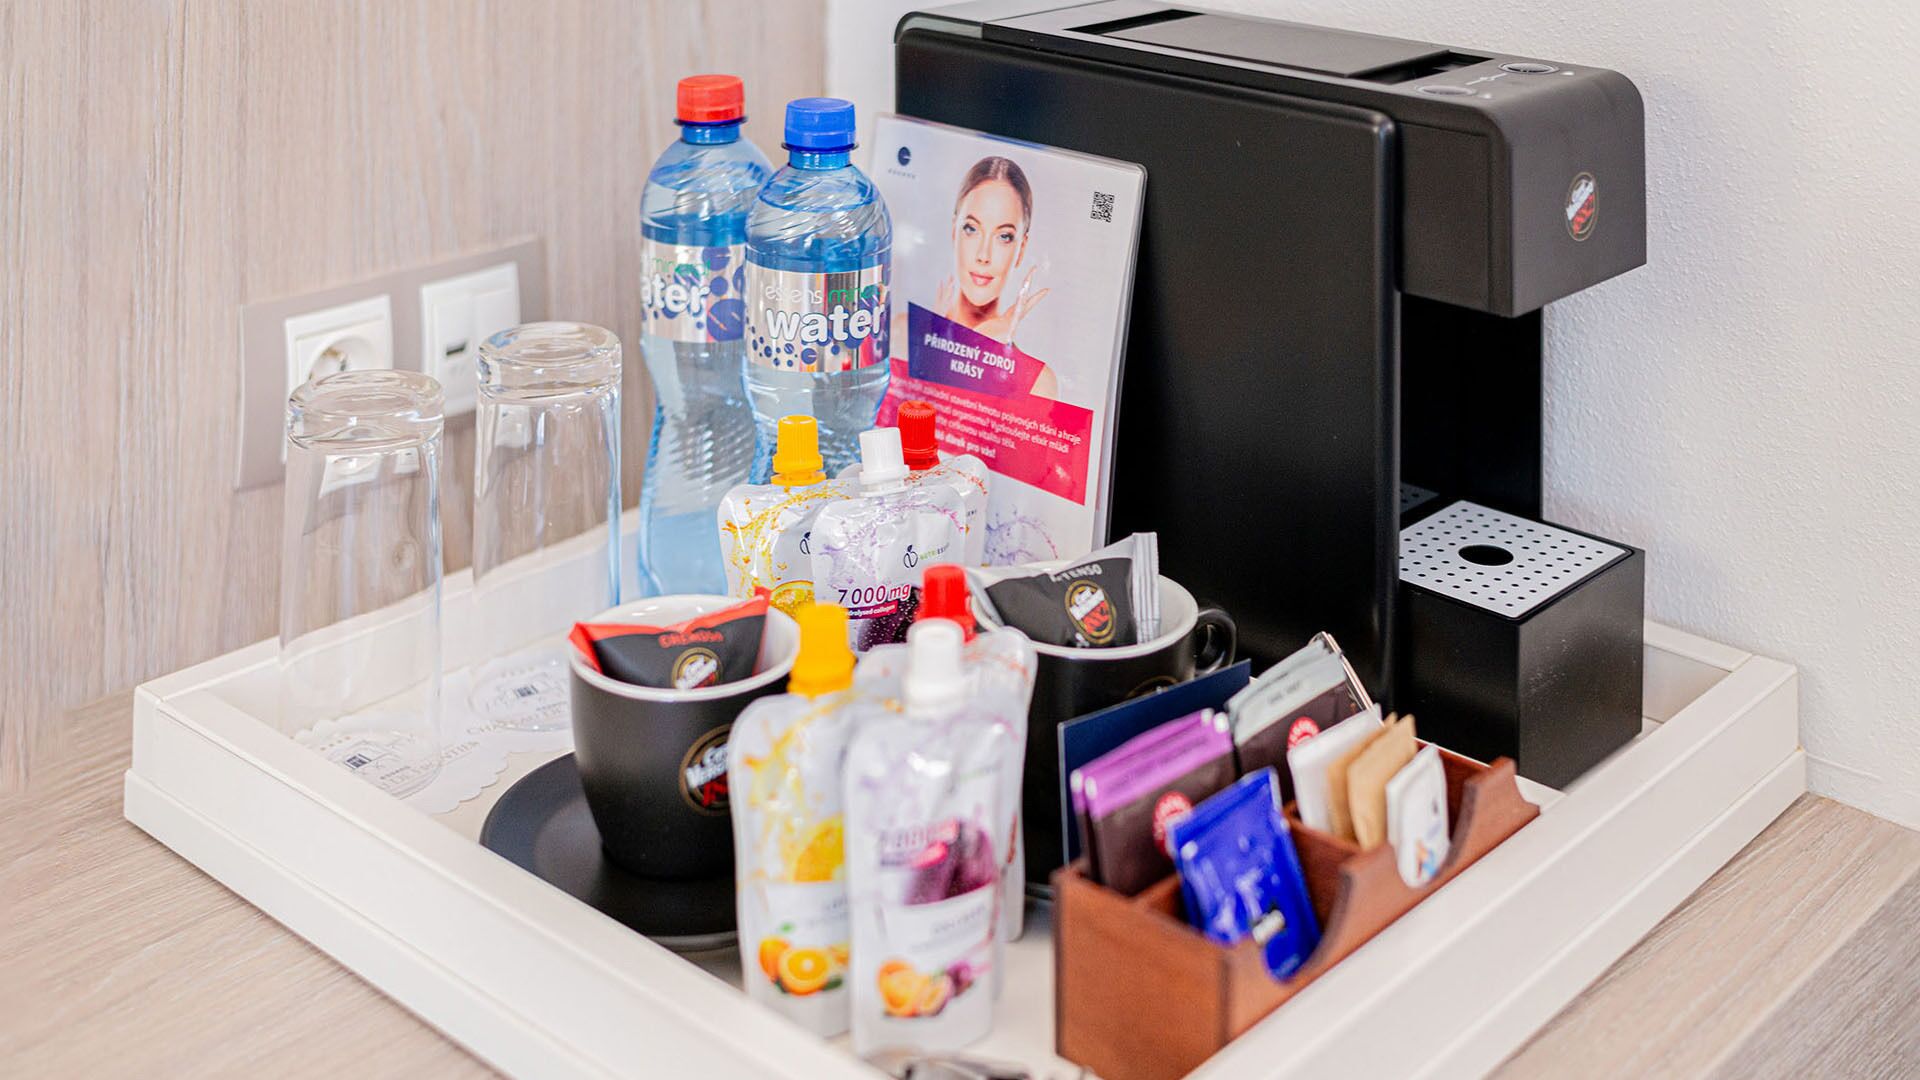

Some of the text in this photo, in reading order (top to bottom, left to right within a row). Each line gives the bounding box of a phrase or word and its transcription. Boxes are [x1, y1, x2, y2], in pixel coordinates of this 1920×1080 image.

[641, 273, 711, 315] ater
[766, 305, 886, 342] water
[924, 334, 1015, 373] PŘIROZENÝ ZDROJ
[950, 359, 984, 380] KRÁSY
[1063, 430, 1082, 445] hraje
[889, 583, 911, 600] mg
